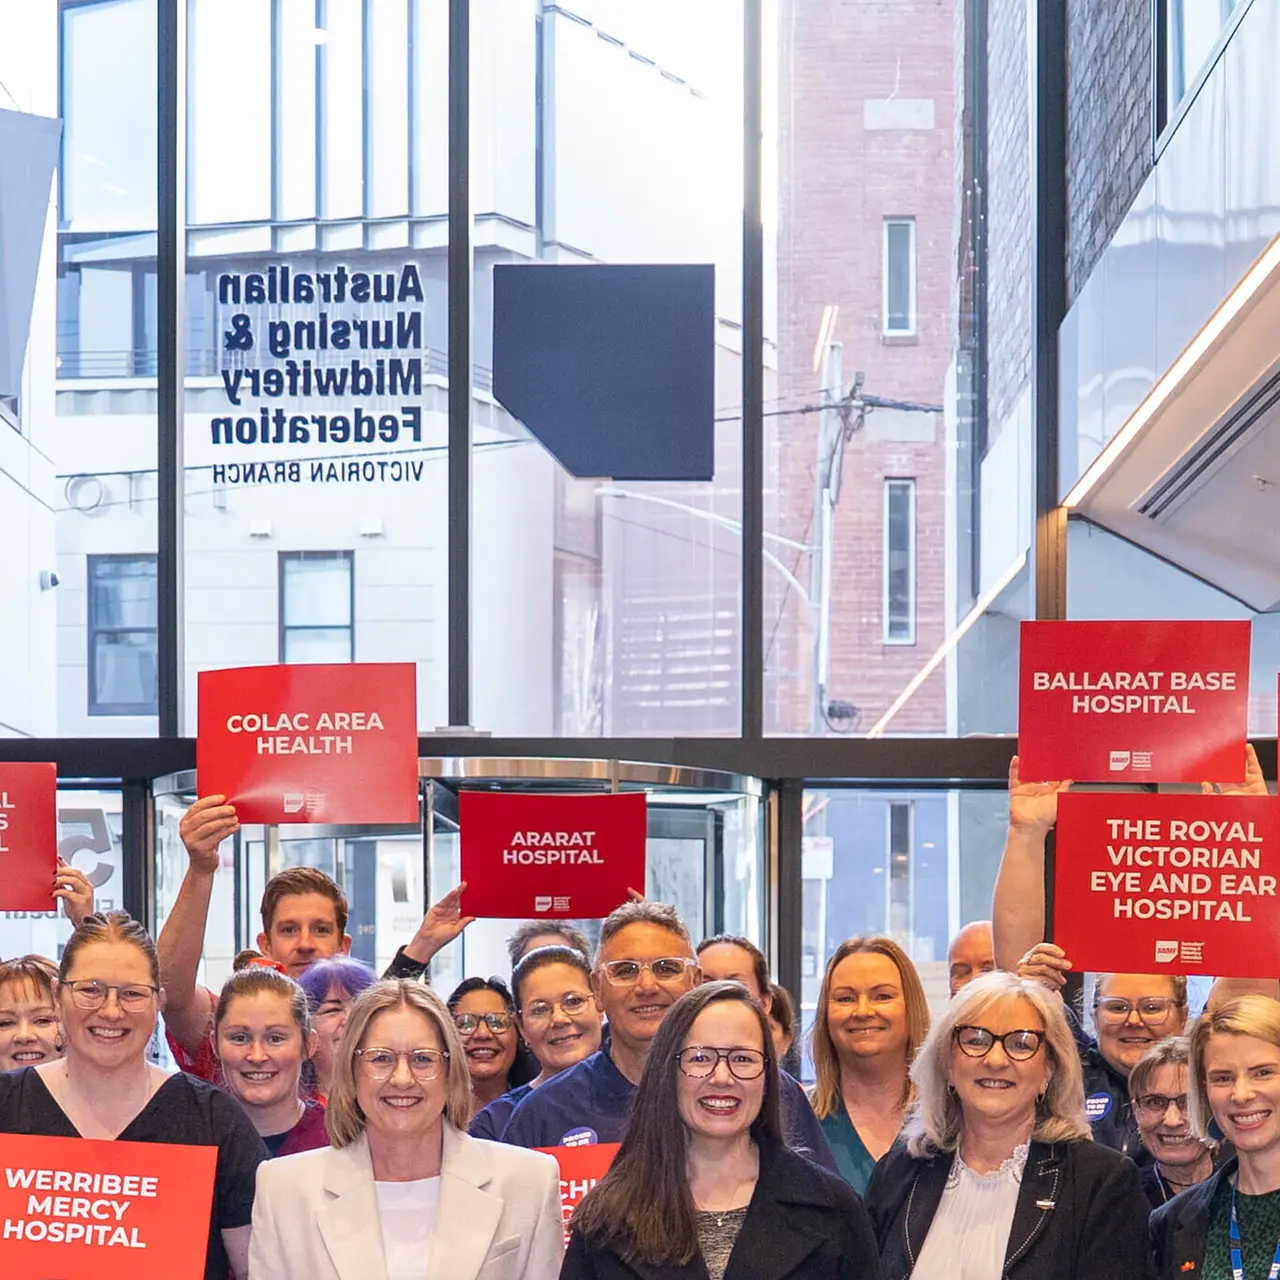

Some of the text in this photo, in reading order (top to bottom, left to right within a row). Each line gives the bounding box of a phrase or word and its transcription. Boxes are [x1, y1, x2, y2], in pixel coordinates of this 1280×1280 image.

[1033, 671, 1237, 691] BALLARAT BASE
[1072, 694, 1197, 714] HOSPITAL
[226, 711, 385, 733] COLAC AREA
[257, 735, 353, 755] HEALTH
[510, 831, 596, 847] ARARAT
[1106, 819, 1264, 843] THE ROYAL
[502, 849, 605, 865] HOSPITAL
[1106, 845, 1261, 869] VICTORIAN
[1090, 871, 1277, 897] EYE AND EAR
[1113, 897, 1252, 922] HOSPITAL
[5, 1167, 159, 1198] WERRIBEE
[27, 1194, 131, 1221] MERCY
[3, 1218, 147, 1248] HOSPITAL
